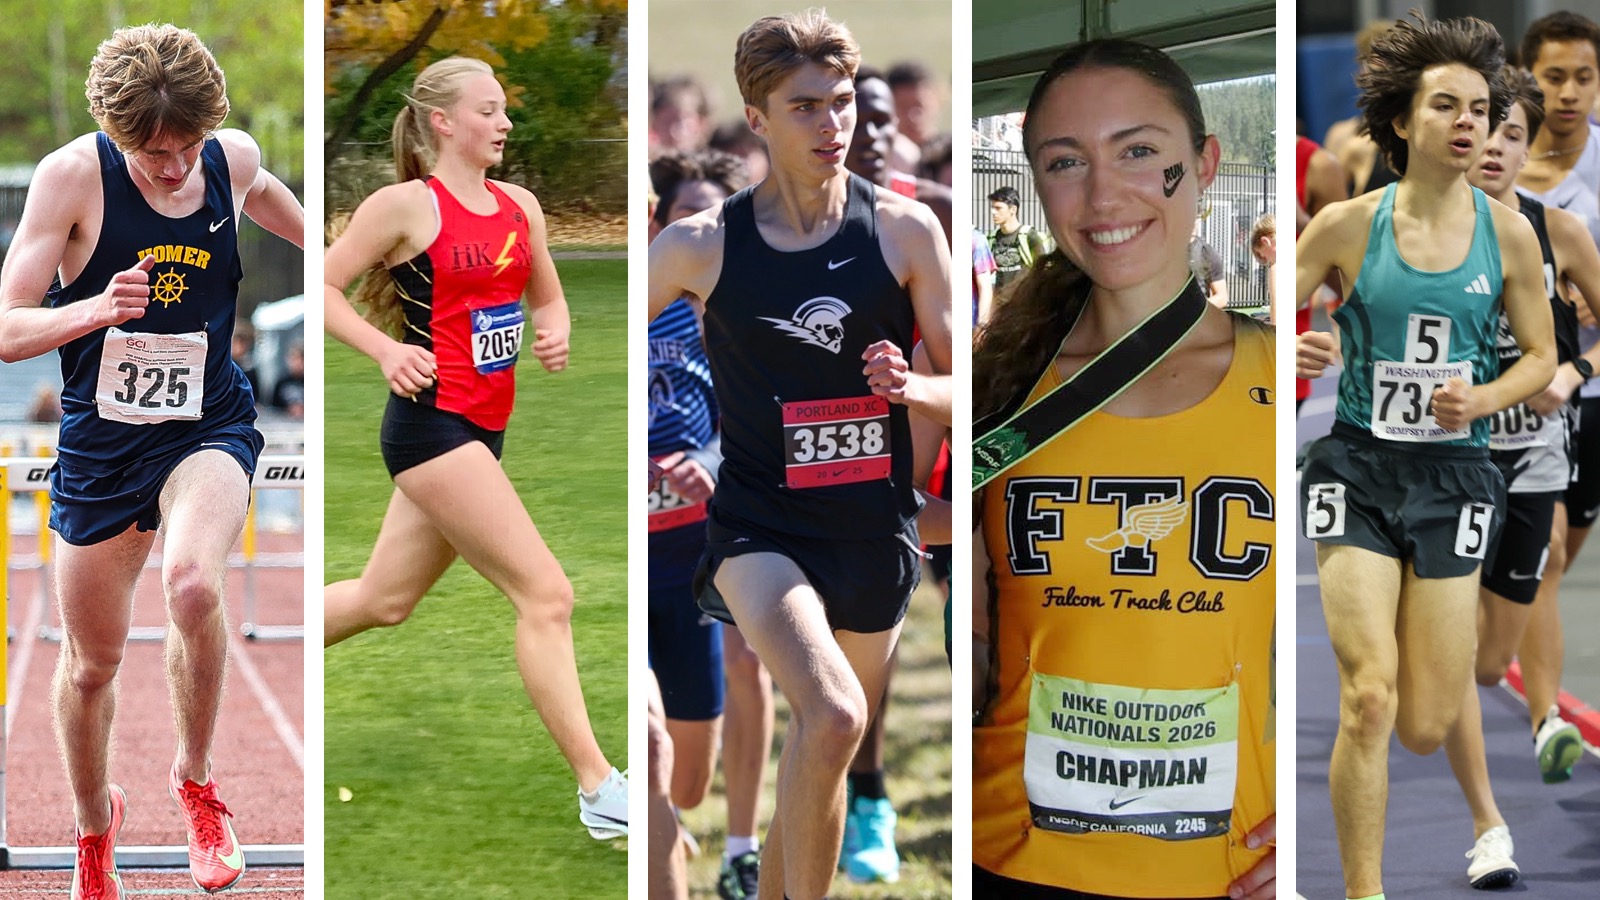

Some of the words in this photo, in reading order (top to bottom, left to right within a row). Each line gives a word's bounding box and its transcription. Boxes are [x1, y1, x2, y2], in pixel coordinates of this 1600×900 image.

[1163, 161, 1184, 184] RUN
[126, 338, 146, 348] GCI
[1415, 319, 1441, 363] 5
[114, 362, 190, 408] 325
[1385, 366, 1463, 379] WASHINGTON
[796, 403, 860, 418] PORTLAND
[864, 400, 878, 413] XC
[793, 421, 884, 463] 3538
[817, 471, 828, 479] 20
[1315, 488, 1336, 533] 5
[1004, 475, 1275, 582] FTC
[1465, 506, 1485, 554] 5
[1042, 586, 1105, 608] Falcon
[1110, 588, 1172, 612] Track
[1176, 590, 1225, 614] Club
[1062, 691, 1107, 716] NIKE
[1114, 700, 1207, 722] OUTDOOR
[1051, 712, 1161, 743] NATIONALS
[1168, 721, 1216, 743] 2026
[1056, 750, 1208, 789] CHAPMAN
[1090, 822, 1167, 835] CALIFORNIA
[1175, 817, 1207, 834] 2245
